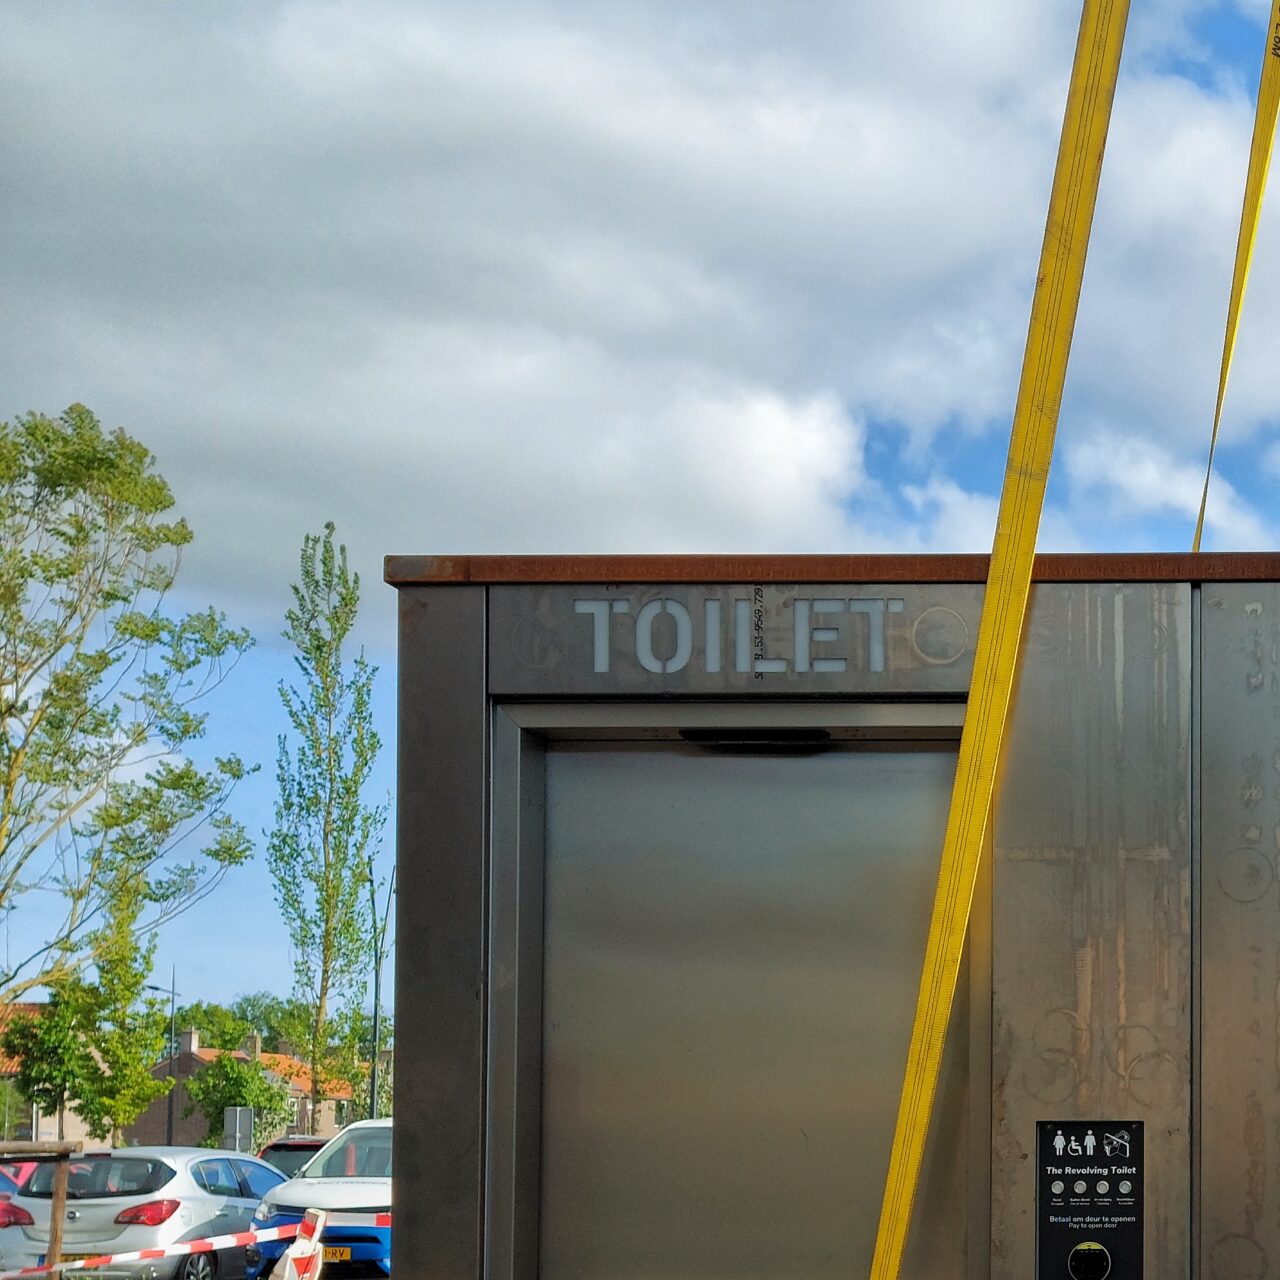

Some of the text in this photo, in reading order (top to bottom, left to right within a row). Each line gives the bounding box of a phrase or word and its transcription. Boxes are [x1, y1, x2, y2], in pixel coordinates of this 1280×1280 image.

[574, 598, 904, 672] TOILET
[1046, 1166, 1136, 1175] The Revolving Toilet
